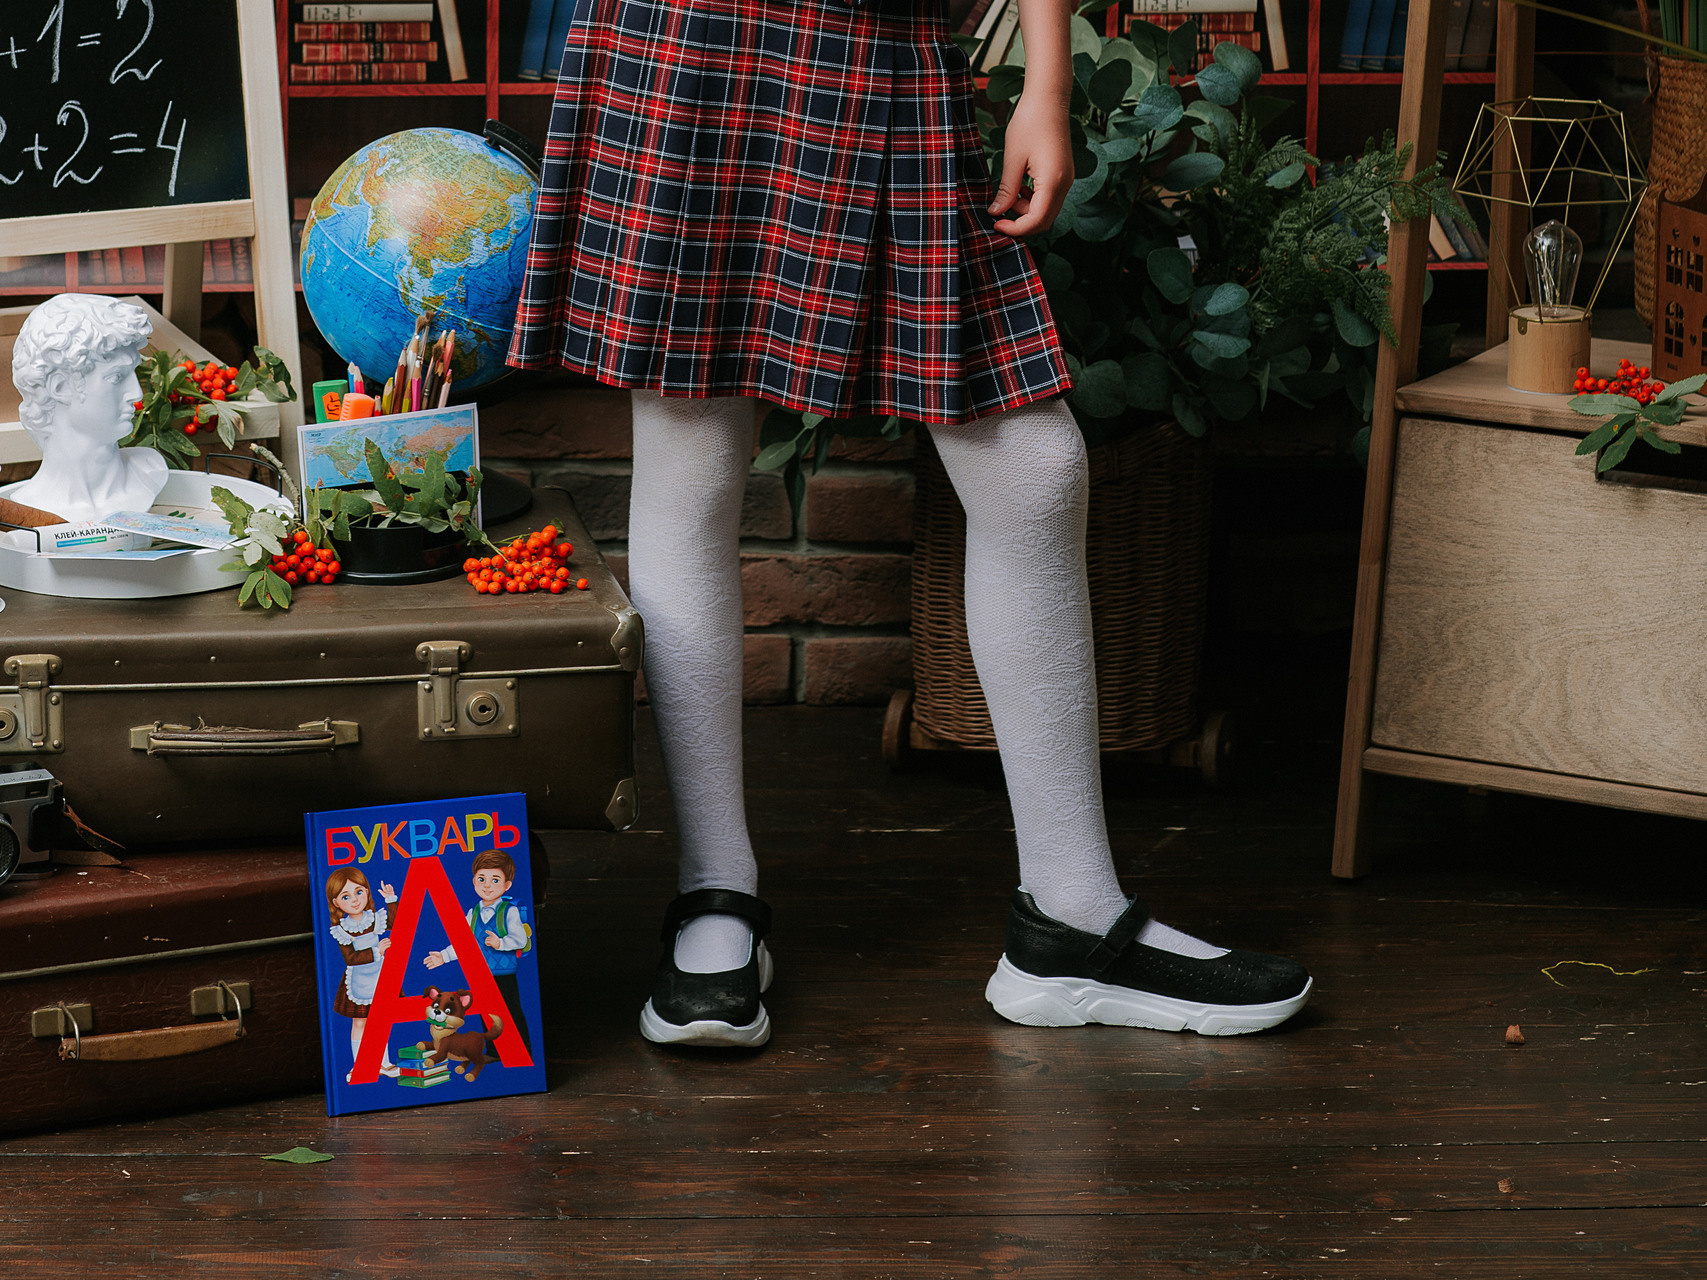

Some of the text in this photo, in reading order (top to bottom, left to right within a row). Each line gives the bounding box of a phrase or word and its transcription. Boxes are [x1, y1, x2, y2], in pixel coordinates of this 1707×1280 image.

[54, 526, 122, 540] КЛЕЙ-КАРАНДА
[325, 812, 521, 867] БУКВАРЬ
[347, 856, 535, 1086] А
